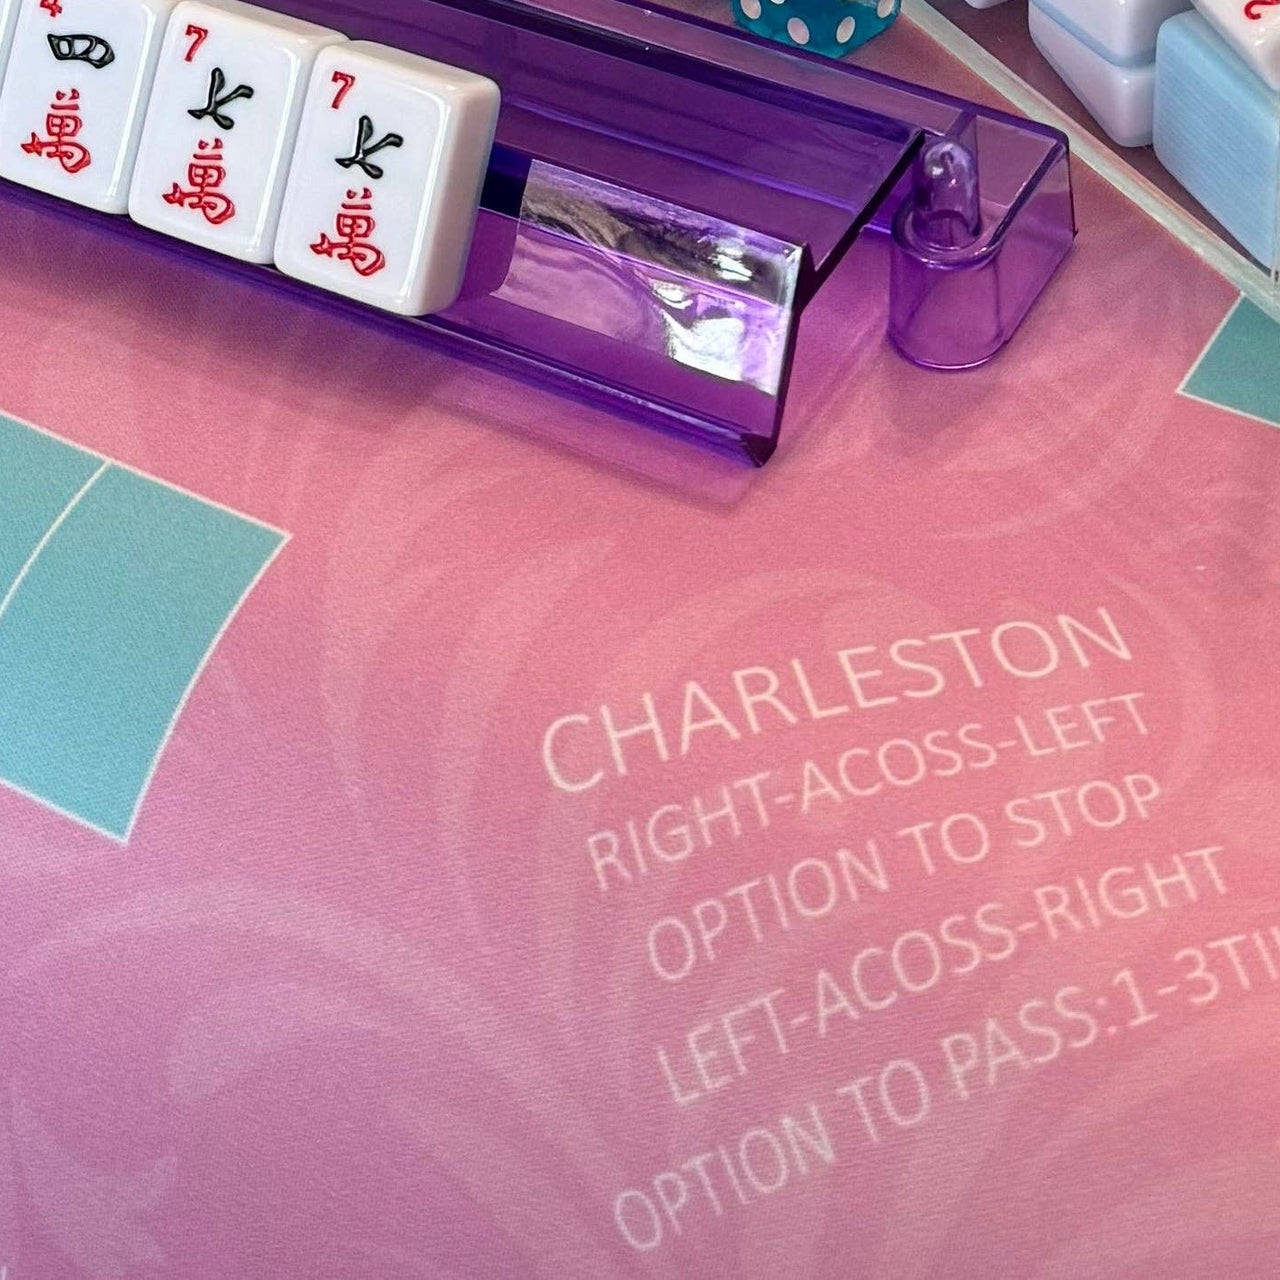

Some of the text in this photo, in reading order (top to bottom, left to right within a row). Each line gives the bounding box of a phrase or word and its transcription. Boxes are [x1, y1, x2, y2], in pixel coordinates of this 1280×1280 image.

[185, 24, 208, 62] 7
[331, 71, 356, 109] 7
[542, 606, 1134, 795] CHARLESTON
[587, 691, 1150, 893] RIGHT-ACOSS-LEFT
[646, 773, 1162, 981] OPTION TO STOP
[656, 846, 1230, 1108] LEFT-ACOSS-RIGHT
[613, 1102, 836, 1253] OPTION
[838, 1059, 933, 1146] TO
